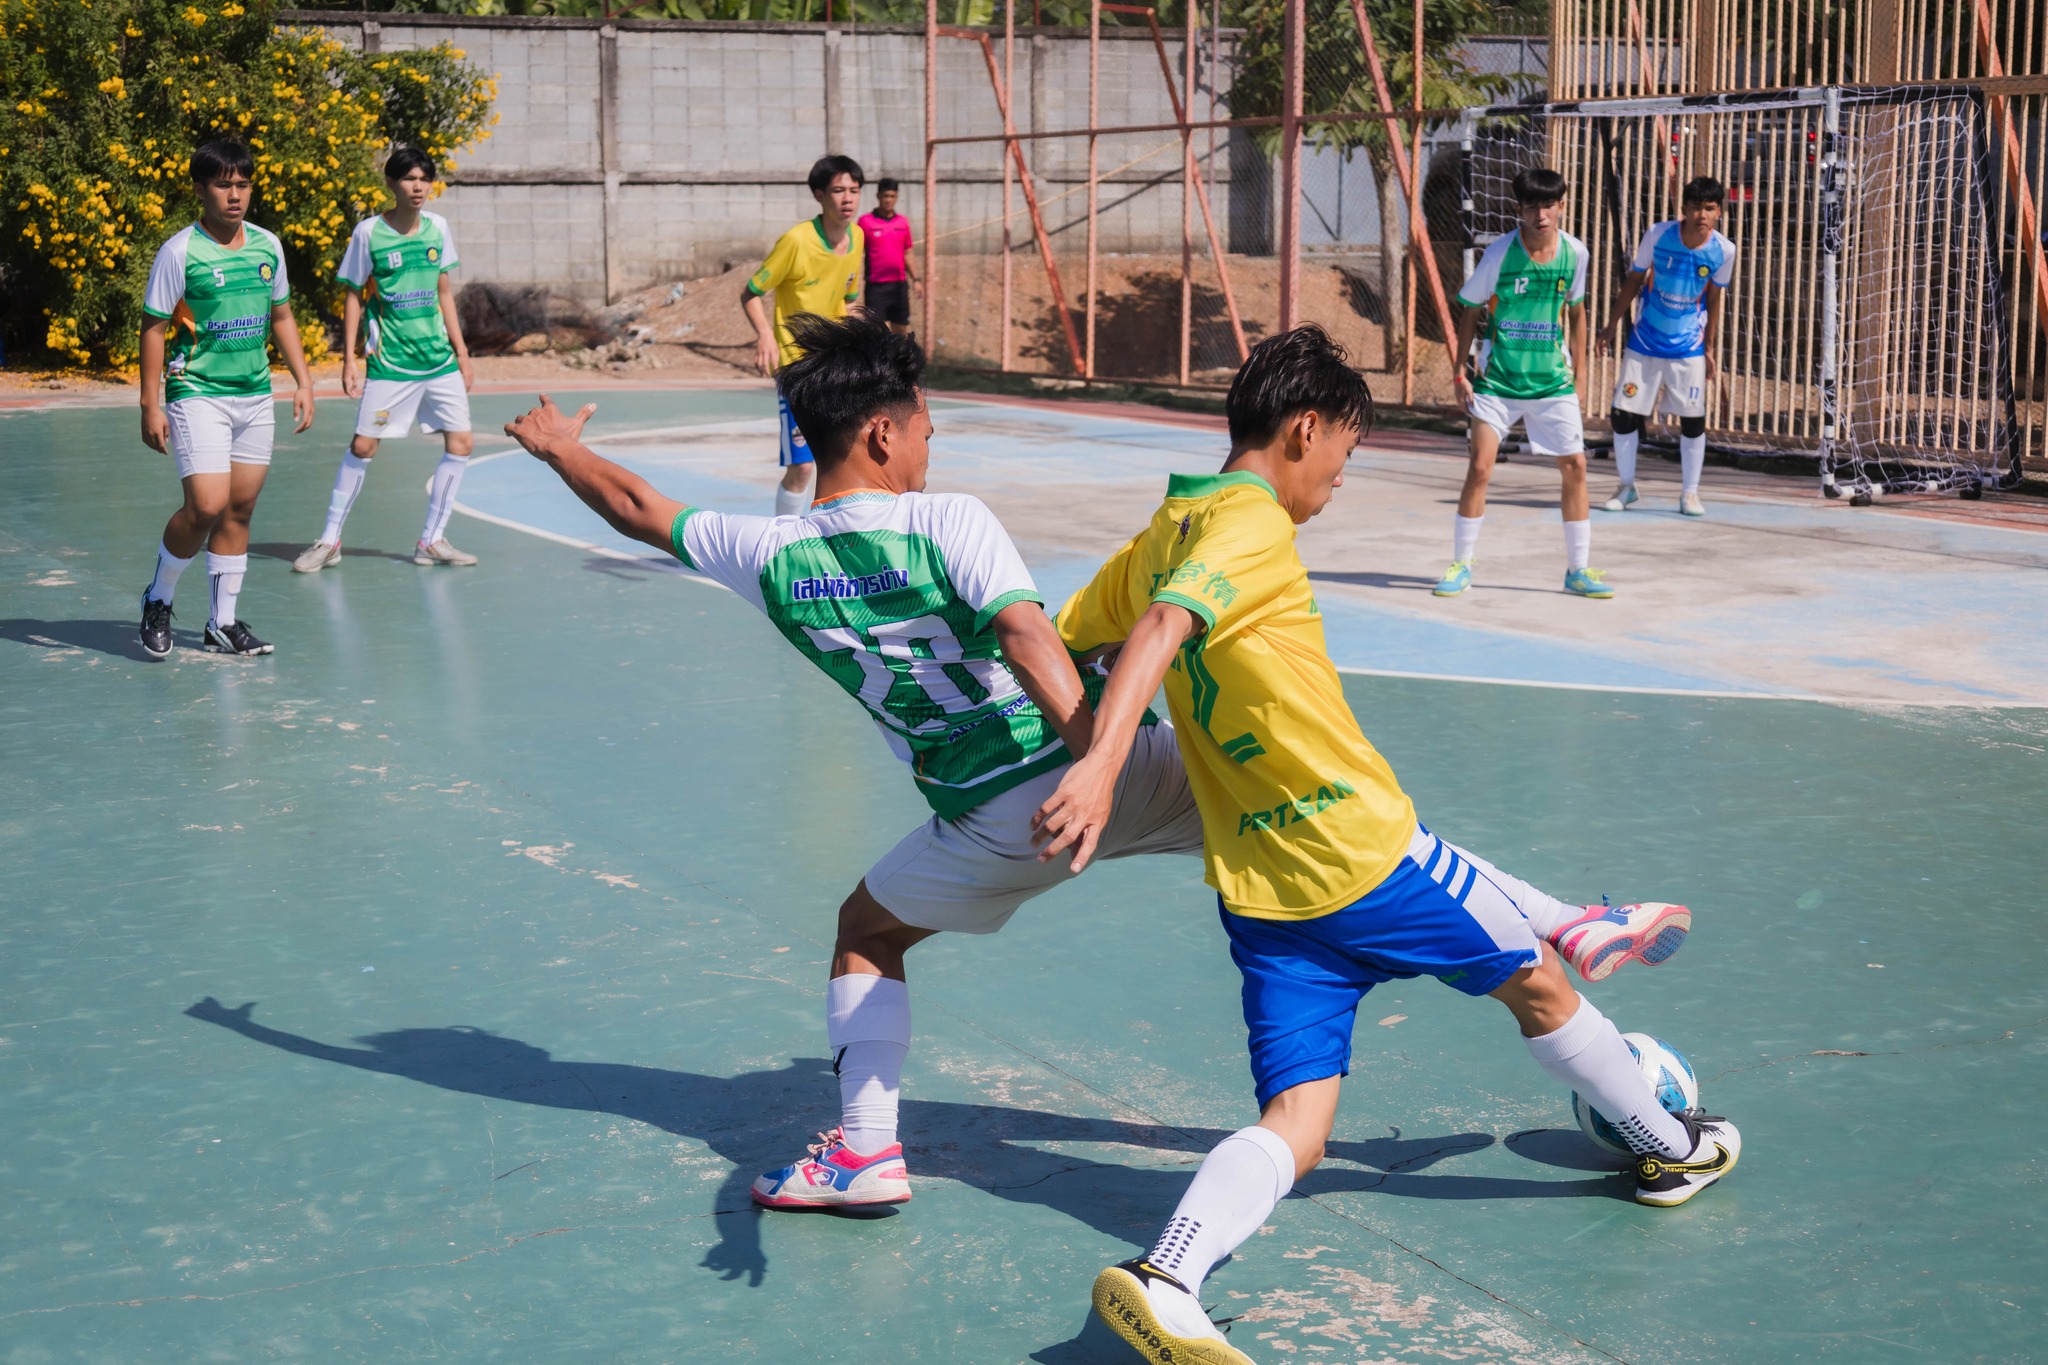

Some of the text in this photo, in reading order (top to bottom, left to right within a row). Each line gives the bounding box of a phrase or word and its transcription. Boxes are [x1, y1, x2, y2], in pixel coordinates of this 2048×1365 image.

[386, 251, 403, 269] 19
[212, 267, 225, 288] 5
[1513, 276, 1530, 295] 12
[1689, 386, 1700, 400] 17
[793, 564, 909, 600] เสน่ห์การช่าง
[1108, 1292, 1173, 1363] TIEMPO
